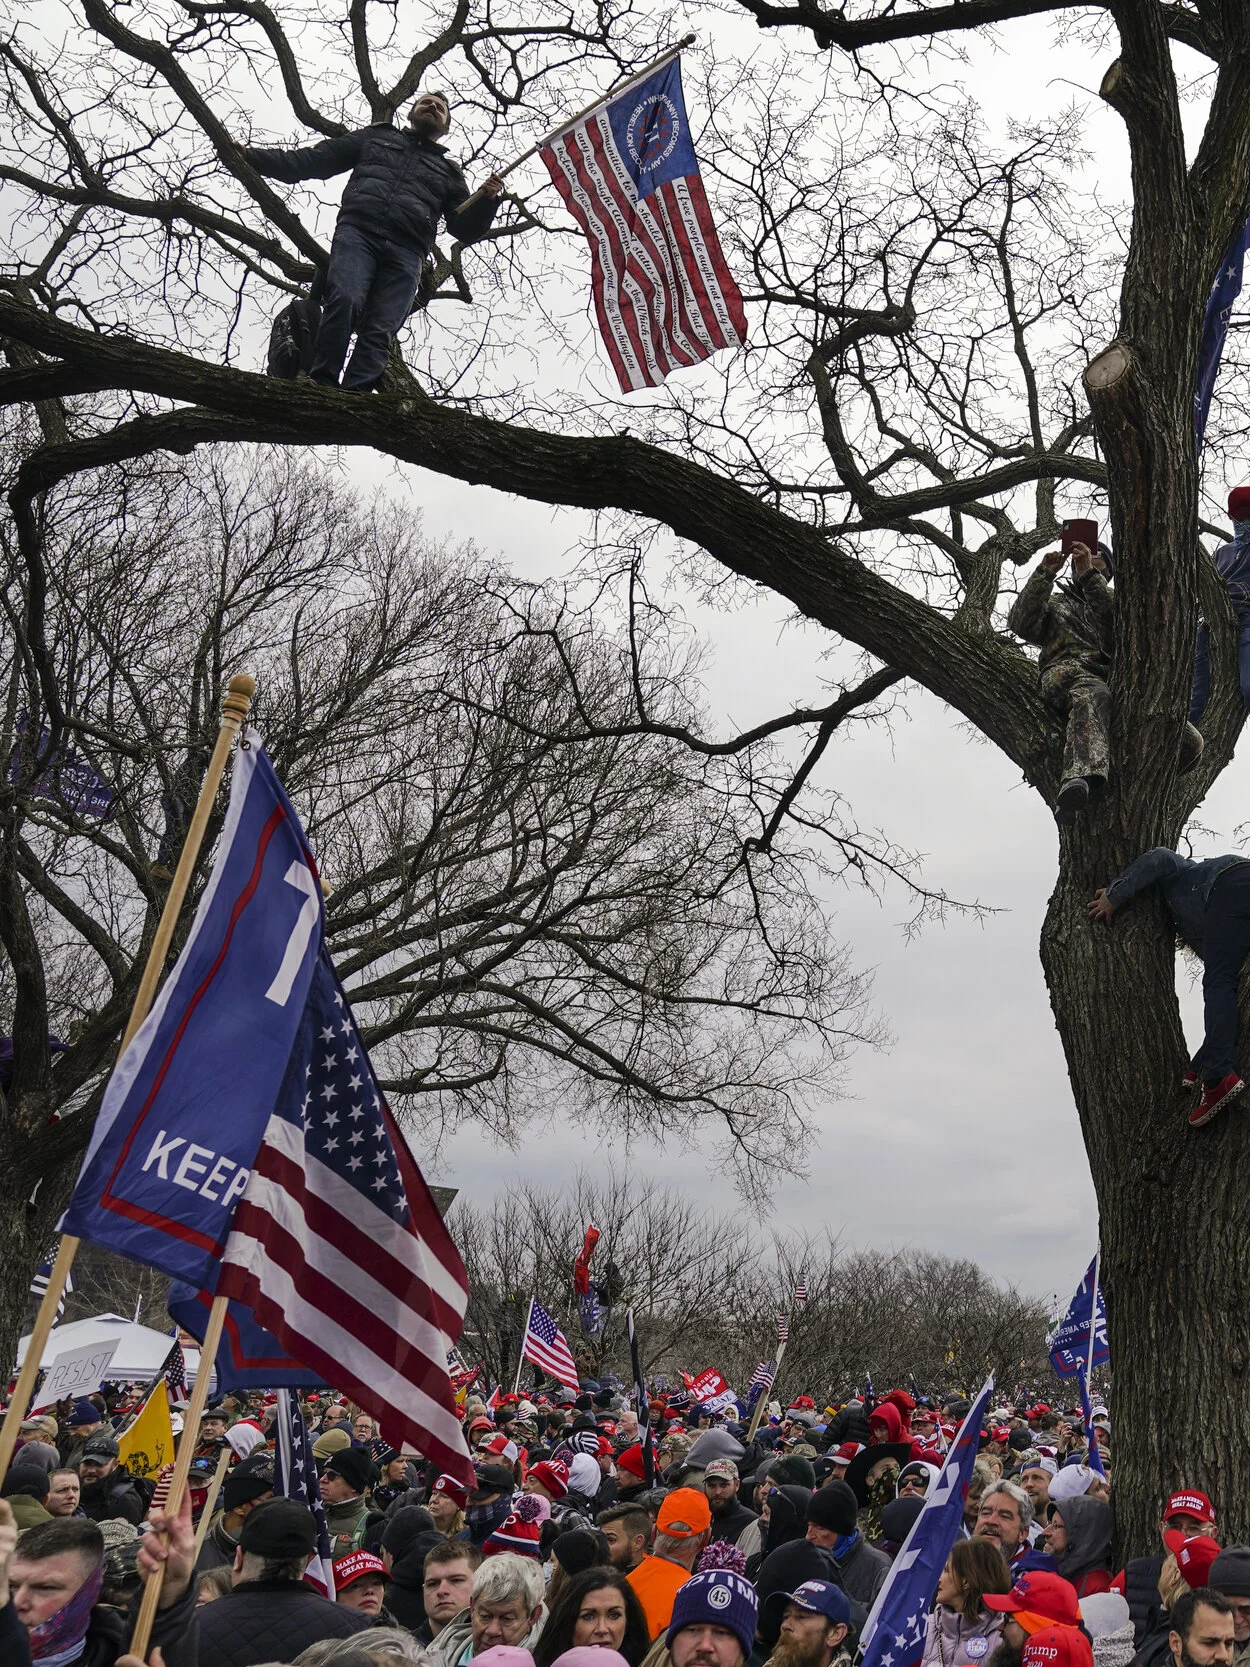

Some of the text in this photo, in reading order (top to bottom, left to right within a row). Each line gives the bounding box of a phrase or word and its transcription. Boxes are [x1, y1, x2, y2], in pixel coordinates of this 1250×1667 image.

[627, 104, 645, 148] REBELLION
[663, 120, 680, 157] BECOMES
[577, 133, 590, 153] any
[586, 155, 597, 176] who
[597, 179, 614, 208] might
[600, 119, 632, 193] ammunition to
[651, 155, 665, 171] LAW
[639, 208, 663, 242] should
[574, 186, 592, 211] Their
[589, 215, 603, 235] own
[611, 314, 636, 370] Washington
[633, 247, 654, 275] status
[678, 197, 691, 216] free
[685, 219, 705, 252] people
[699, 255, 715, 282] ought
[709, 285, 721, 300] not
[716, 303, 728, 325] only
[637, 303, 649, 336] Which
[643, 339, 657, 370] would
[690, 309, 703, 329] But
[141, 1130, 250, 1207] KEEP
[336, 1555, 357, 1572] MAKE
[342, 1562, 364, 1577] GREAT
[713, 1590, 727, 1604] 45
[1024, 1644, 1058, 1659] Trump
